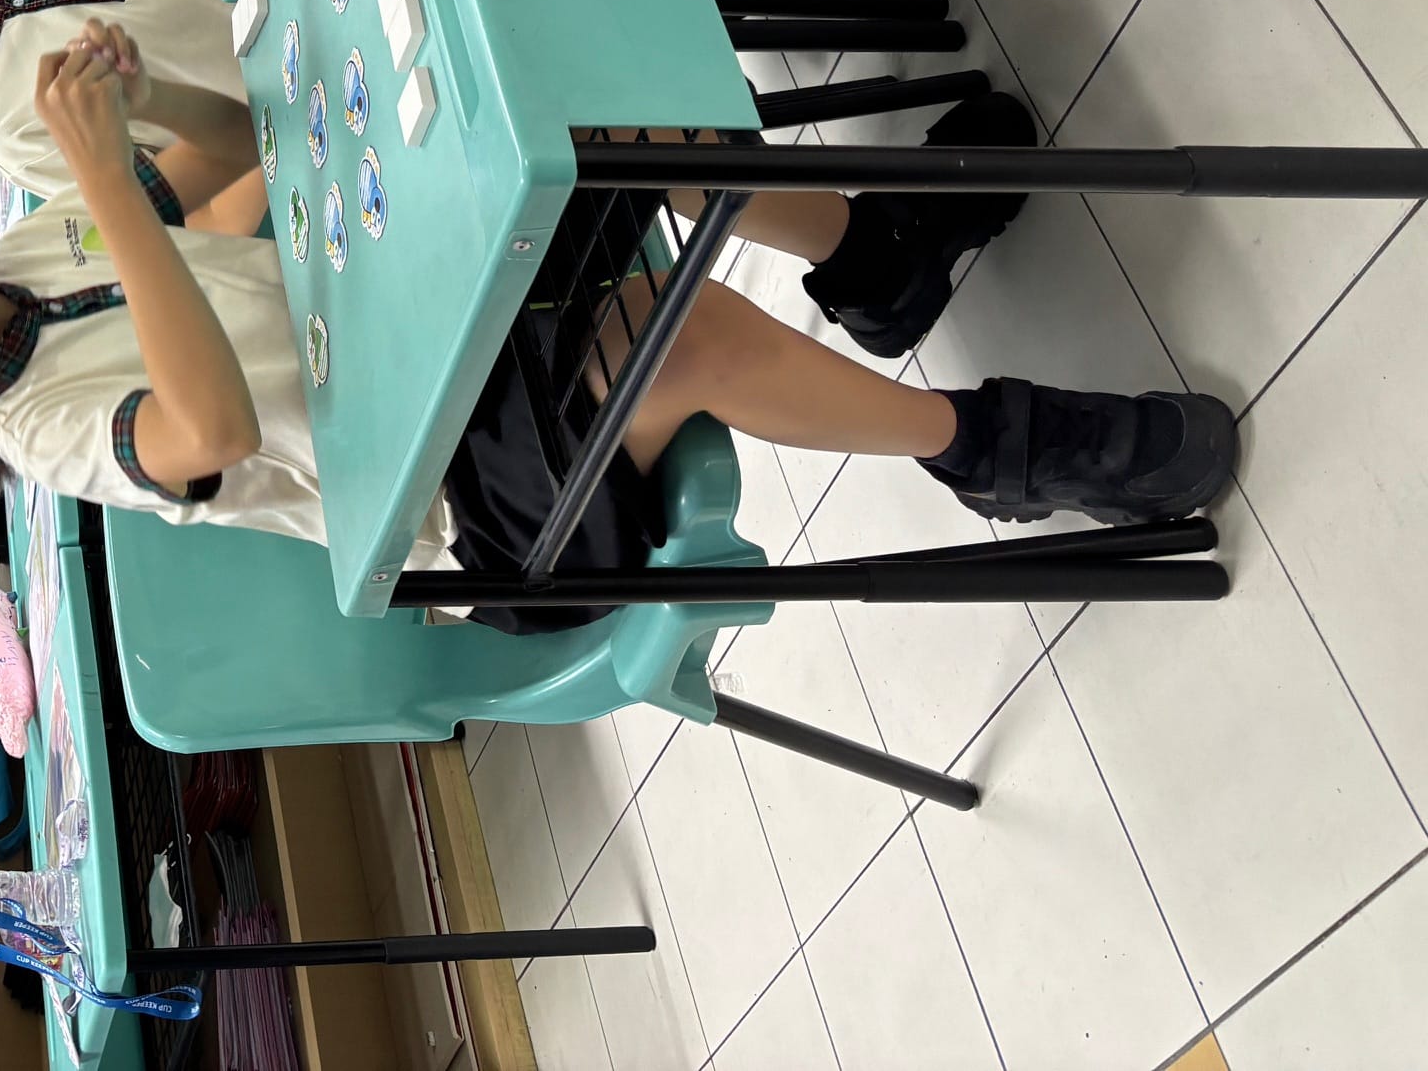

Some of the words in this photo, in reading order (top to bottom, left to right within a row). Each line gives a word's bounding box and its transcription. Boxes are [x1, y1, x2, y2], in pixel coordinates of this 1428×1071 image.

[14, 921, 40, 935] KEEPER
[16, 955, 33, 963] CUP
[158, 1003, 172, 1013] CUP
